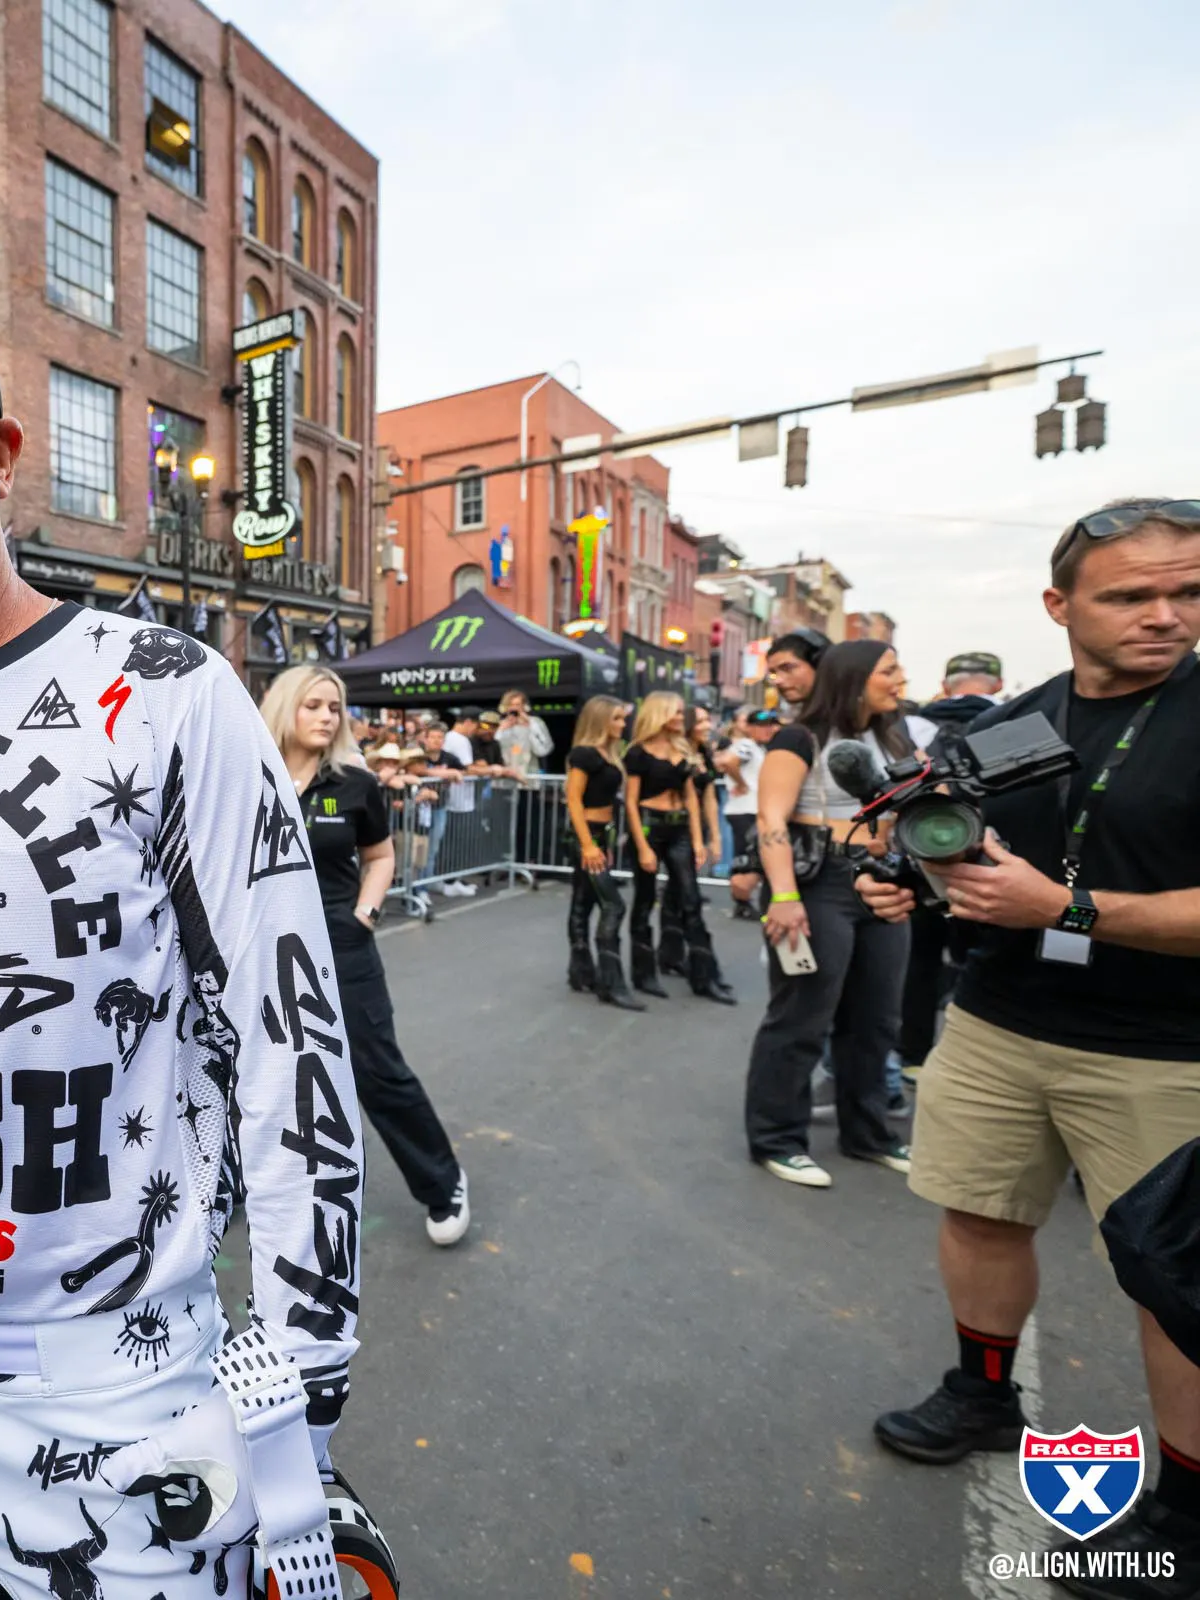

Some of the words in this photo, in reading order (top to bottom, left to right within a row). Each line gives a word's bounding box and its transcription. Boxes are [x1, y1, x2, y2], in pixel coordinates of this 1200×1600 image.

[249, 352, 276, 512] WHISKEY
[233, 502, 295, 546] Row
[380, 667, 477, 687] MONSTER
